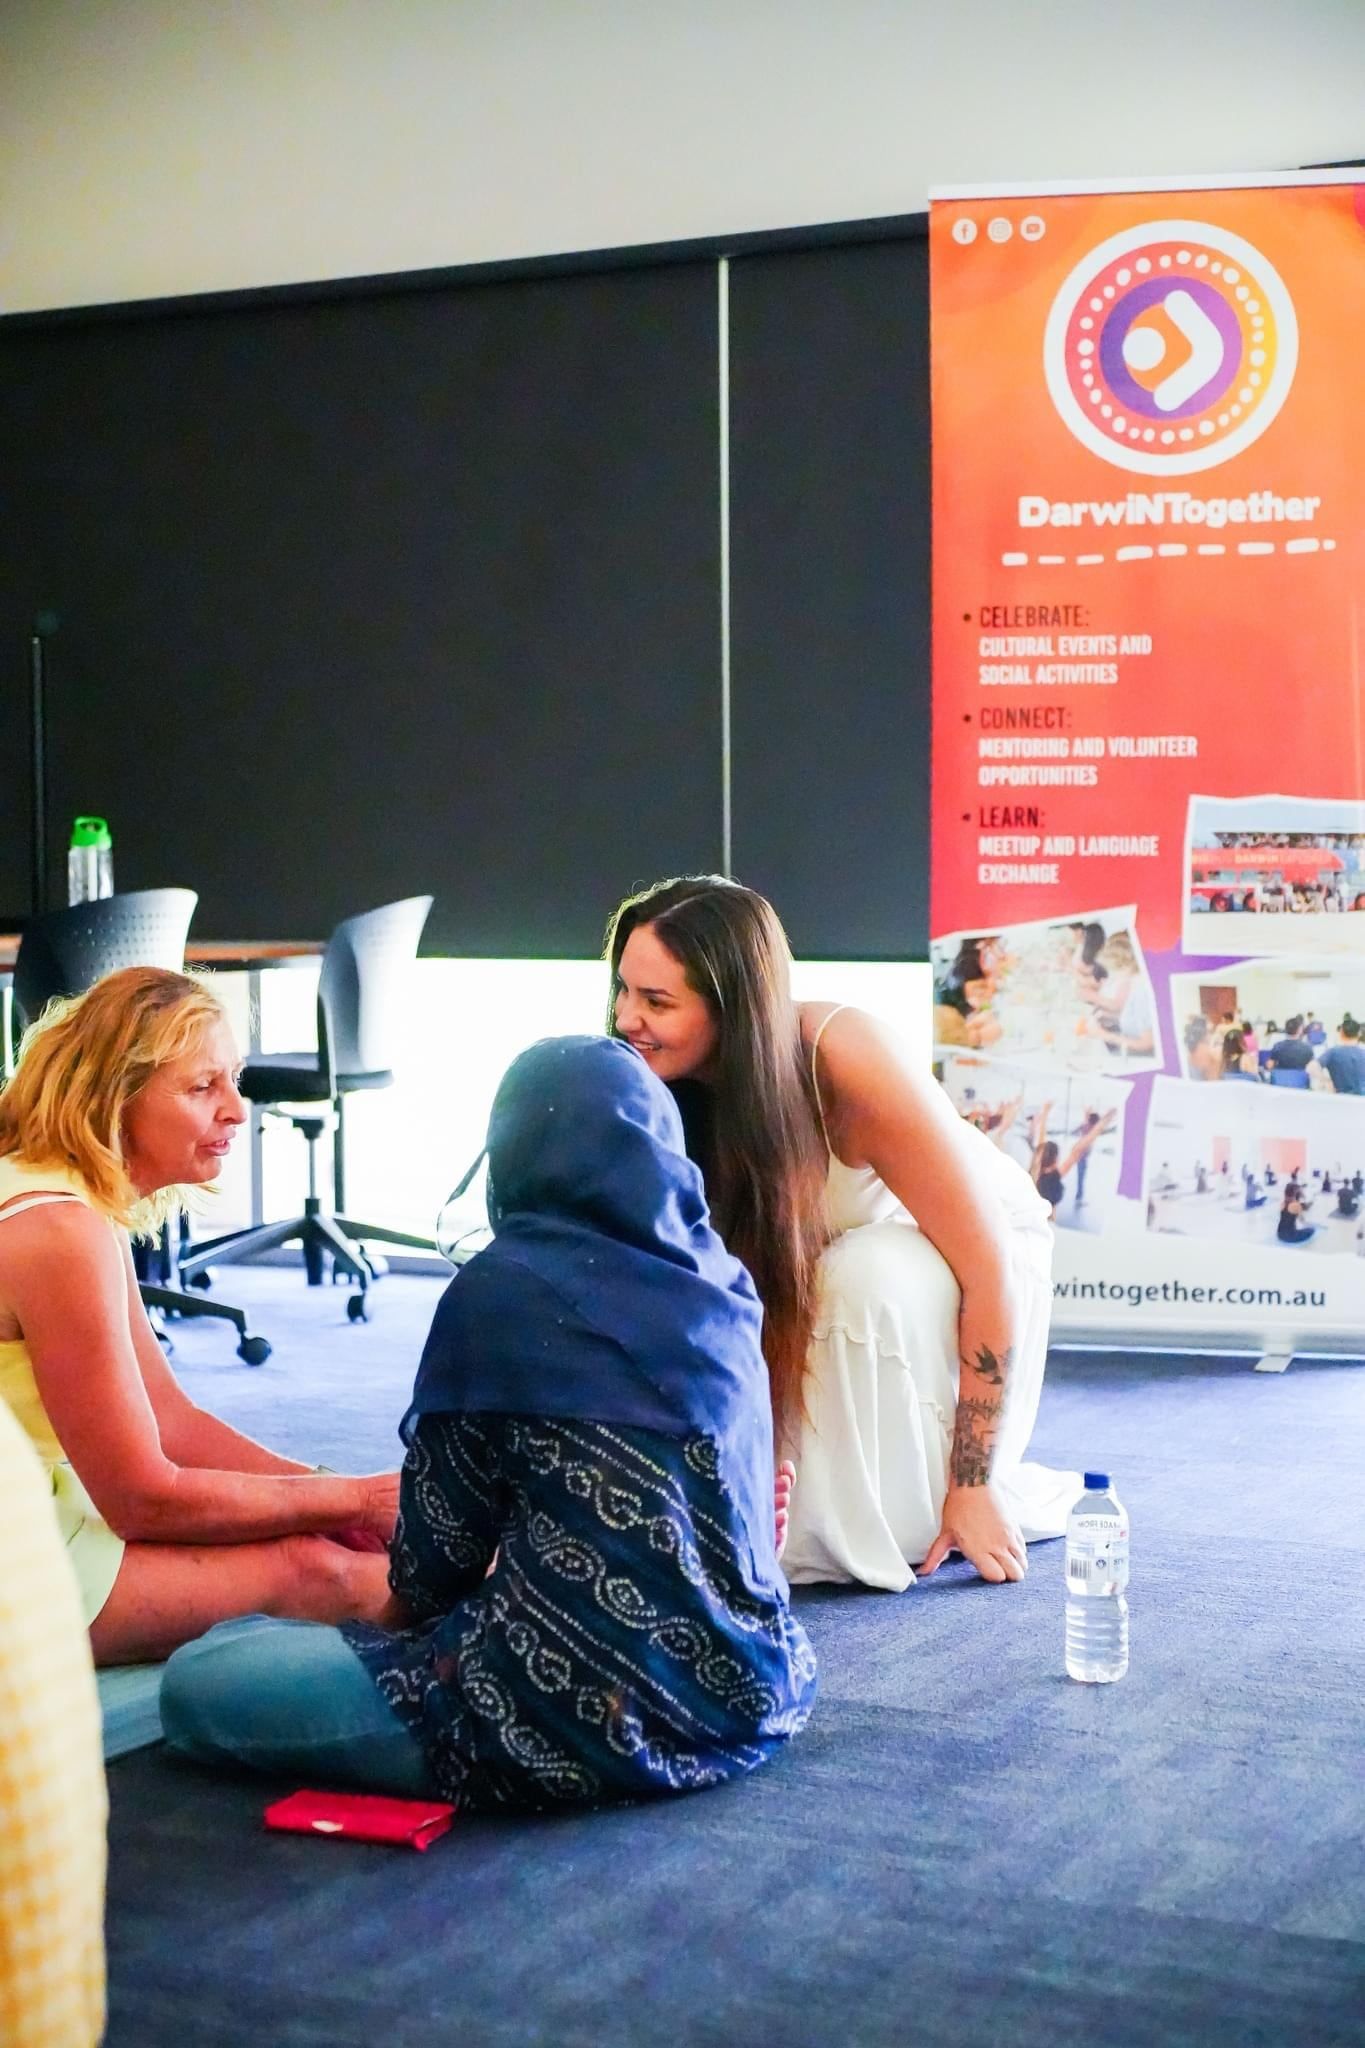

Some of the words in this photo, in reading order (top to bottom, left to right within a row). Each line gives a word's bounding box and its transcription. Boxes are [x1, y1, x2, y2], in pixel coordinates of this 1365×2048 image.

[1018, 490, 1321, 528] DarwiNTogether
[979, 605, 1091, 628] CELEBRATE:
[979, 635, 1056, 657] CULTURAL
[1058, 634, 1117, 656] EVENTS
[1119, 633, 1153, 655] AND
[979, 664, 1032, 685] SOCIAL
[1035, 663, 1119, 684] ACTIVITIES
[979, 706, 1073, 729] CONNECT:
[978, 737, 1070, 758] MENTORING
[1072, 736, 1106, 758] AND
[1108, 735, 1199, 758] VOLUNTEER
[978, 764, 1099, 786] OPPORTUNITIES
[979, 806, 1046, 828] LEARN:
[978, 835, 1041, 857] MEETUP
[1042, 835, 1076, 857] AND
[1078, 835, 1160, 857] LANGUAGE
[978, 863, 1060, 885] EXCHANGE
